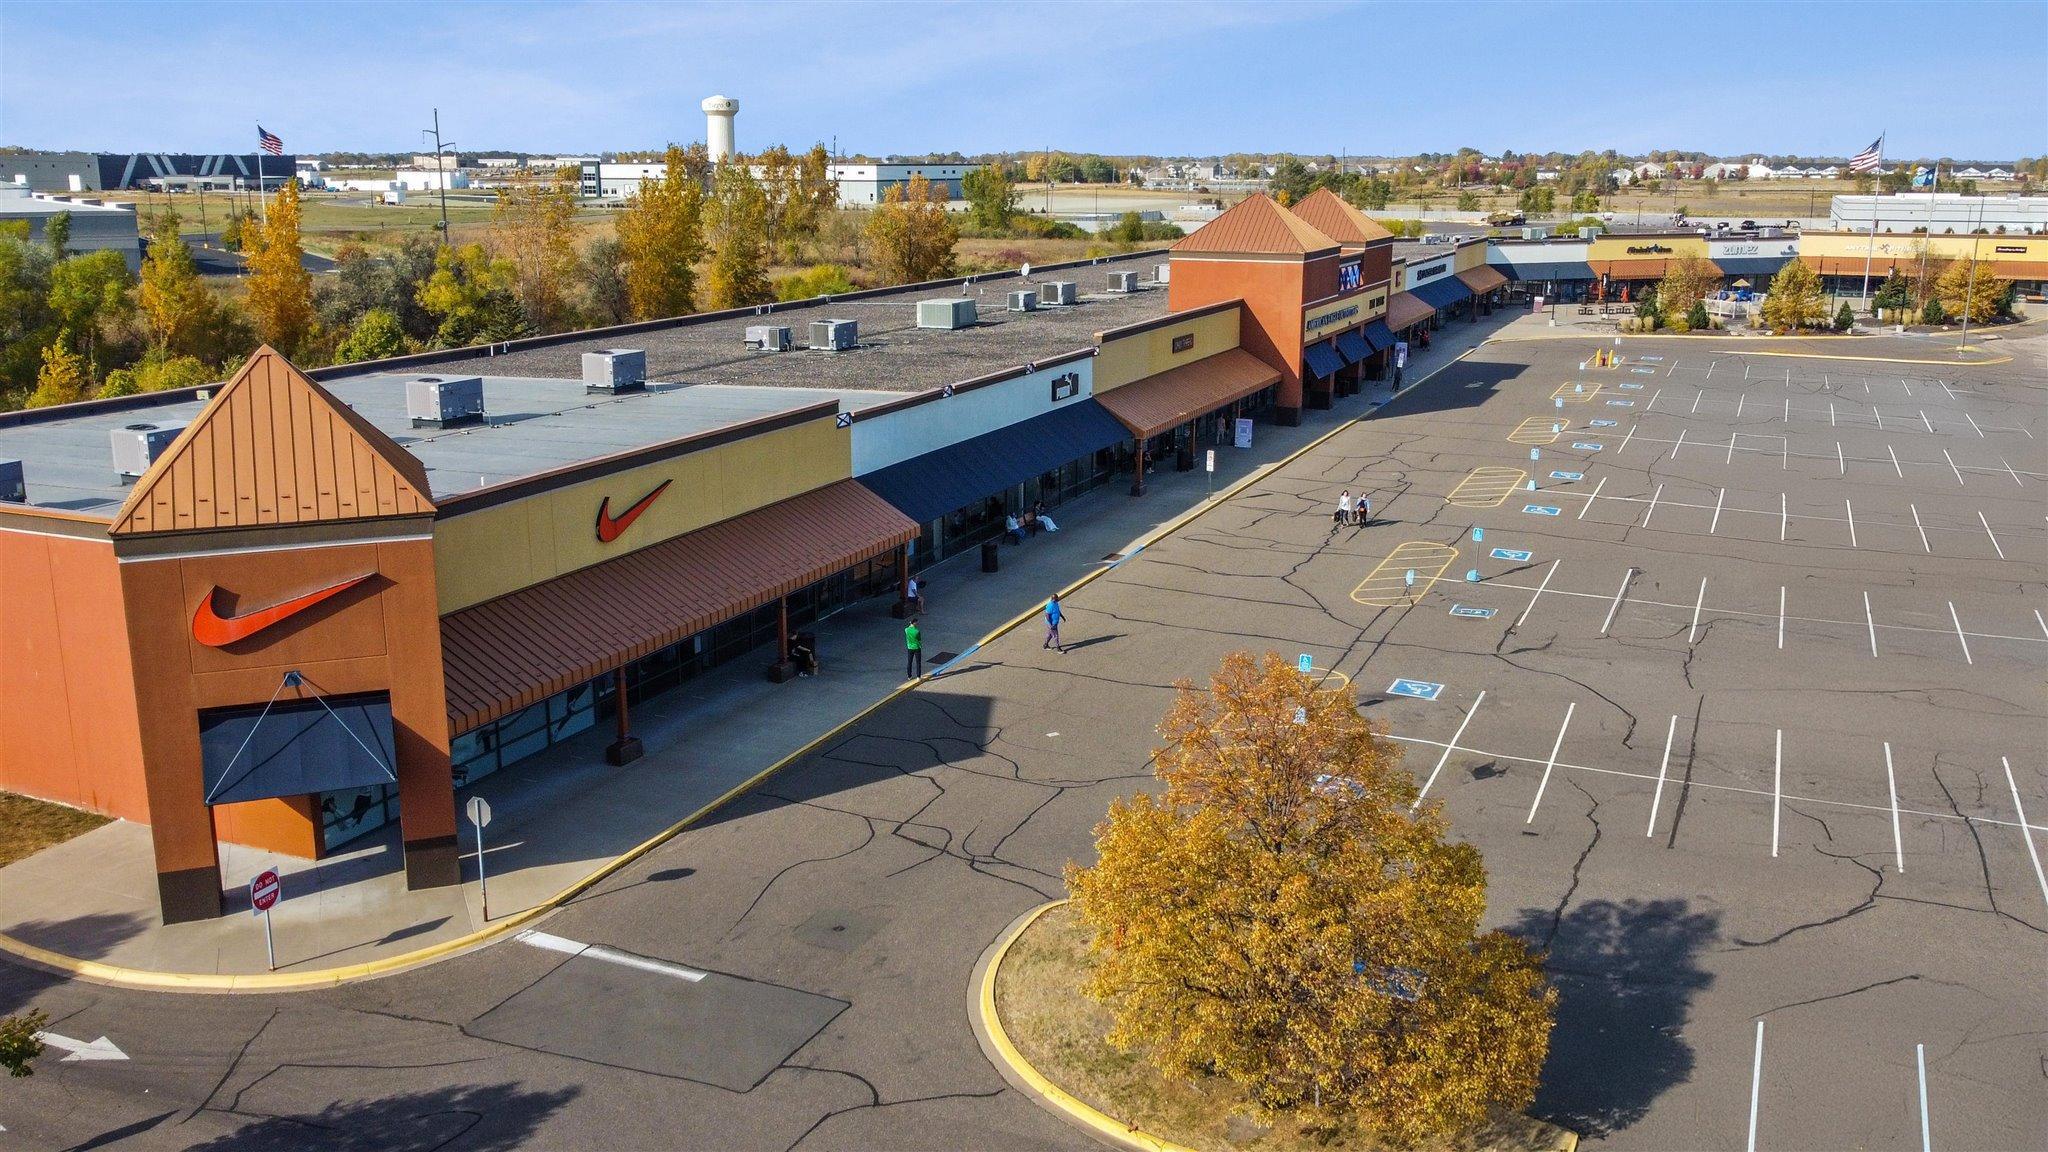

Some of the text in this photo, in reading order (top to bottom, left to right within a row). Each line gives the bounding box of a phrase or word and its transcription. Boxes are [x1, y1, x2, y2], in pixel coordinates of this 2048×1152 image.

[255, 875, 275, 890] DO NOT
[259, 892, 275, 906] ENTER
